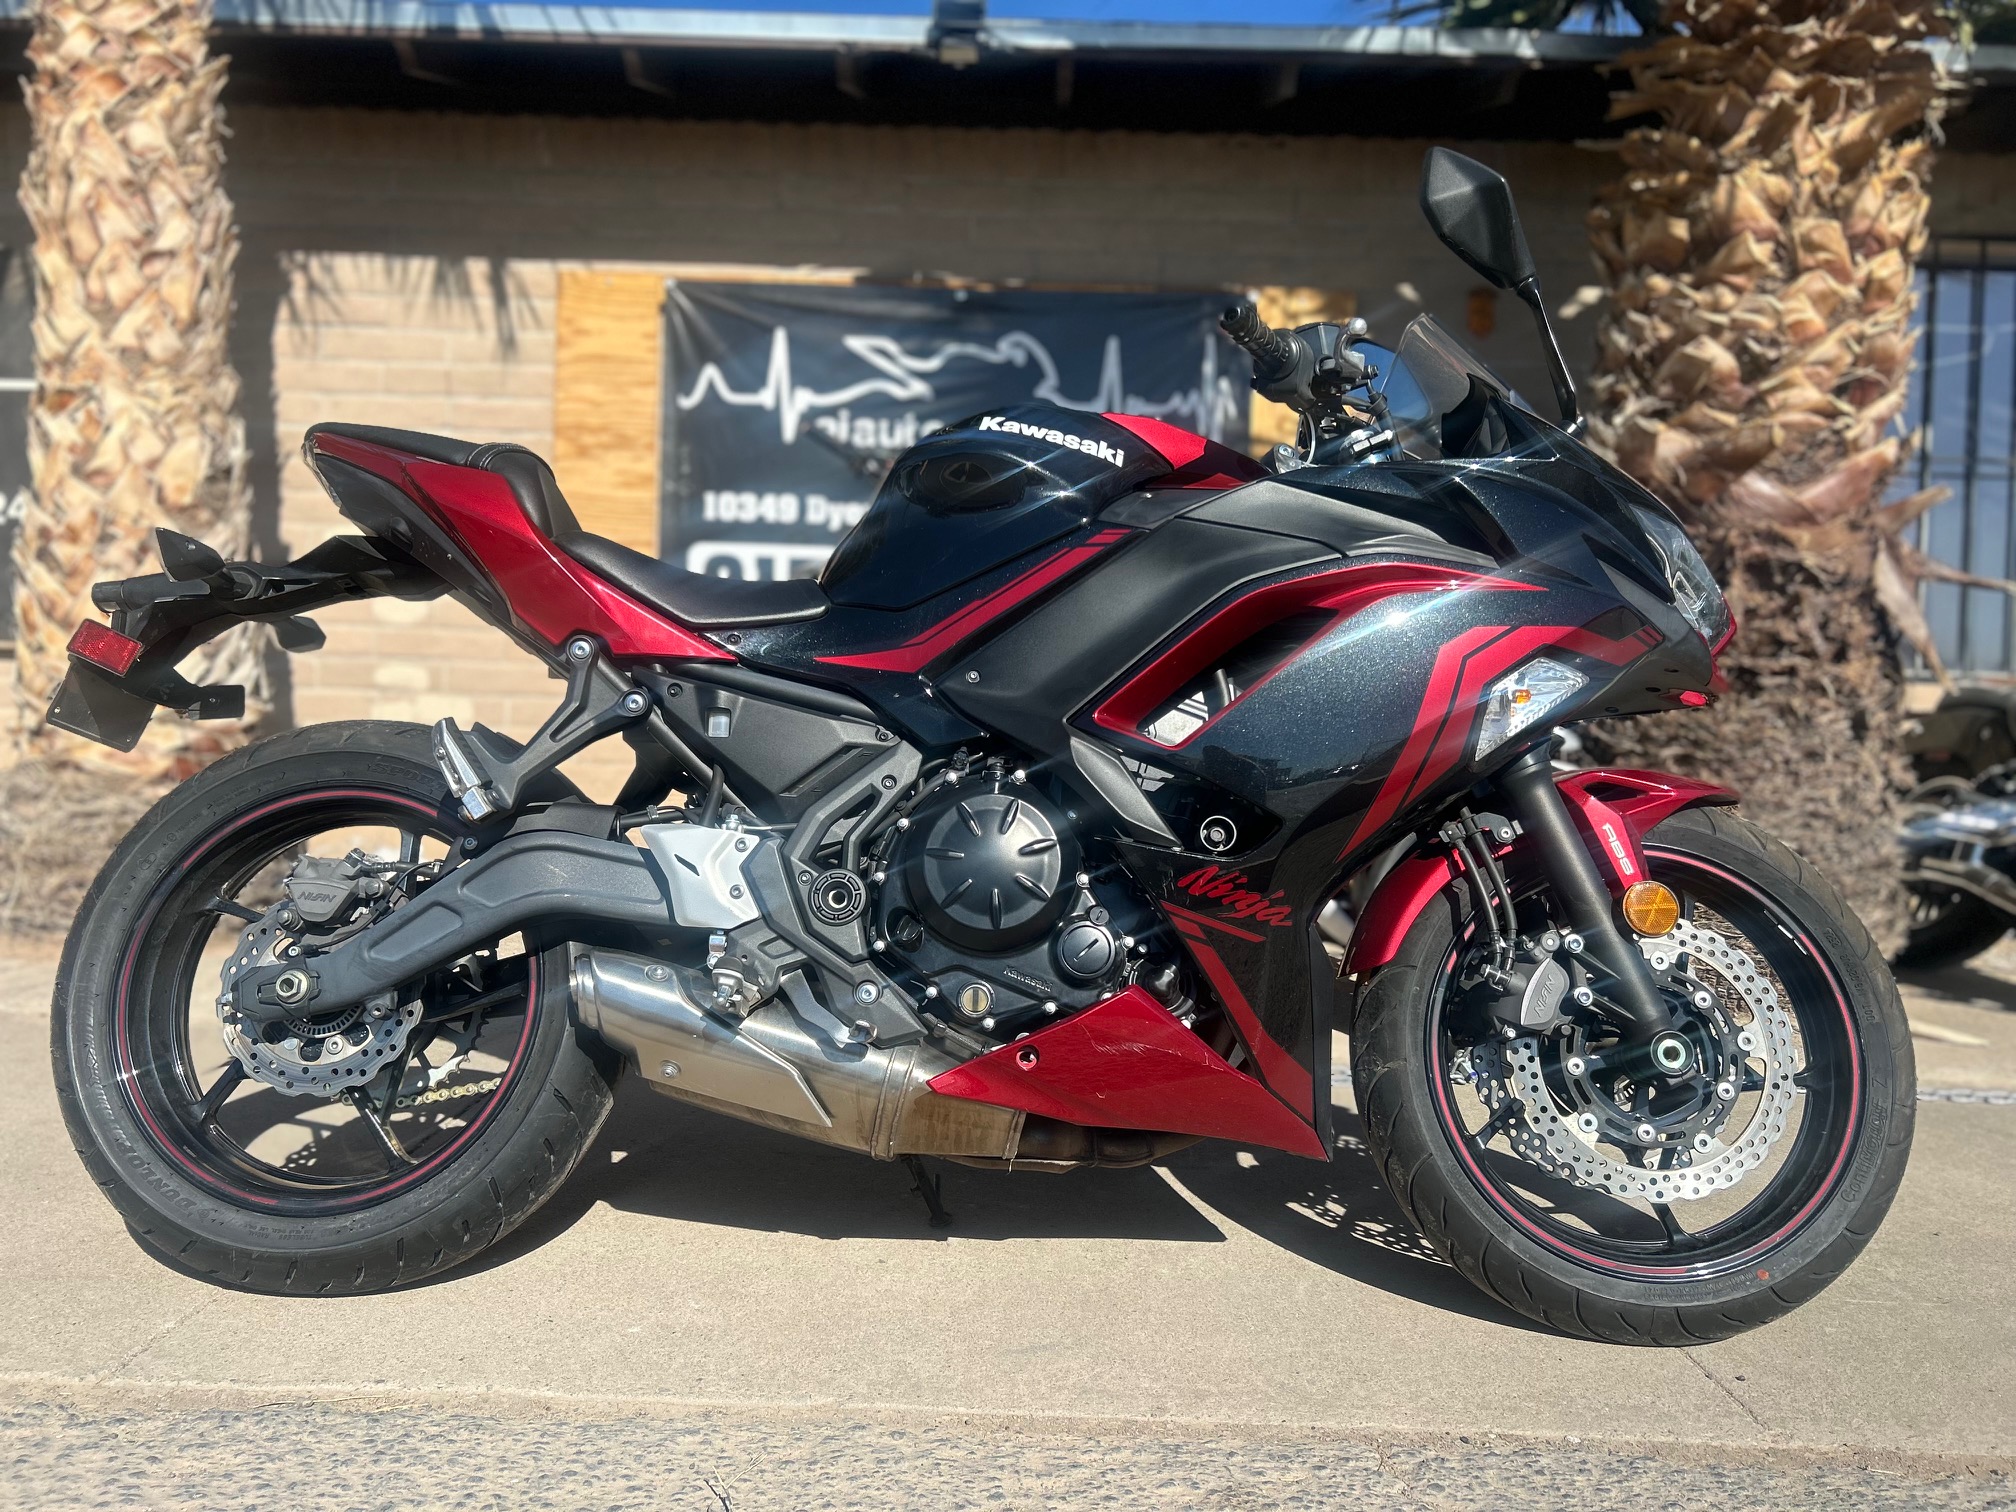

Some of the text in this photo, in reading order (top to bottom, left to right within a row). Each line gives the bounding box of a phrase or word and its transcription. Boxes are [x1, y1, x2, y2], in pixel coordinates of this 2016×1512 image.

[979, 416, 1125, 468] Kawasaki
[703, 491, 799, 524] 10349
[1602, 822, 1635, 876] ABS
[1177, 864, 1293, 927] Ninja
[1003, 964, 1053, 992] Kawasaki
